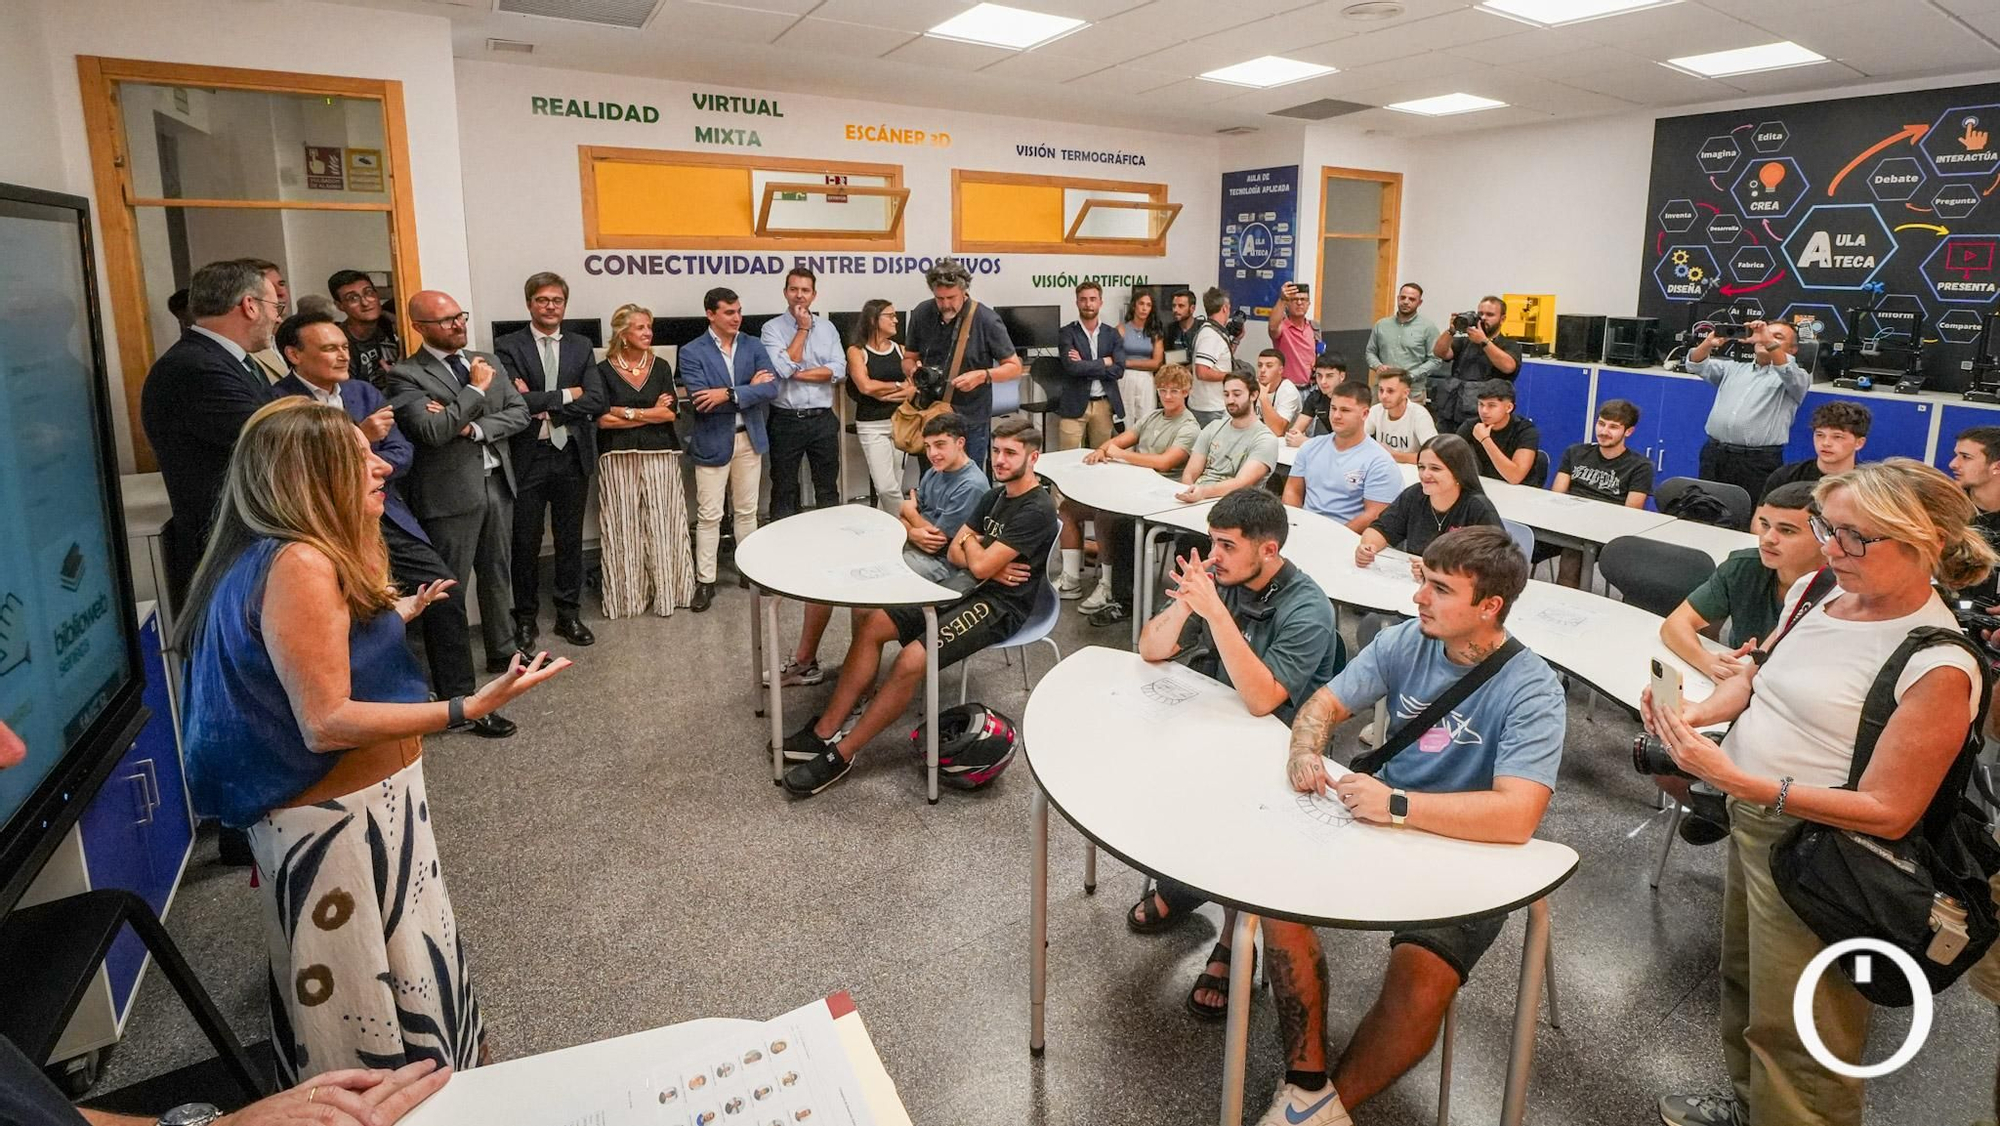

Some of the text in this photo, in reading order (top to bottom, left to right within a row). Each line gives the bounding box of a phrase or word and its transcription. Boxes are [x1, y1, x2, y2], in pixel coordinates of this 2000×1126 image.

[531, 96, 660, 124] REALIDAD
[692, 92, 784, 118] VIRTUAL
[694, 126, 762, 147] MIXTA
[1757, 132, 1783, 142] Edita
[1016, 143, 1146, 166] VISIÓN TERMOGRÁFICA
[1700, 150, 1737, 160] Imagina
[1935, 150, 1998, 164] INTERACTÚA
[1874, 174, 1919, 184] Debate
[1750, 201, 1780, 211] CREA
[1934, 198, 1977, 206] Pregunta
[584, 254, 785, 275] CONECTIVIDAD
[793, 256, 866, 274] ENTRE
[1737, 261, 1765, 269] Fabrica
[1032, 271, 1078, 288] VISIÓN
[1667, 282, 1702, 294] DISEÑA
[1937, 281, 1996, 292] PRESENTA
[1939, 322, 1983, 331] Comparte
